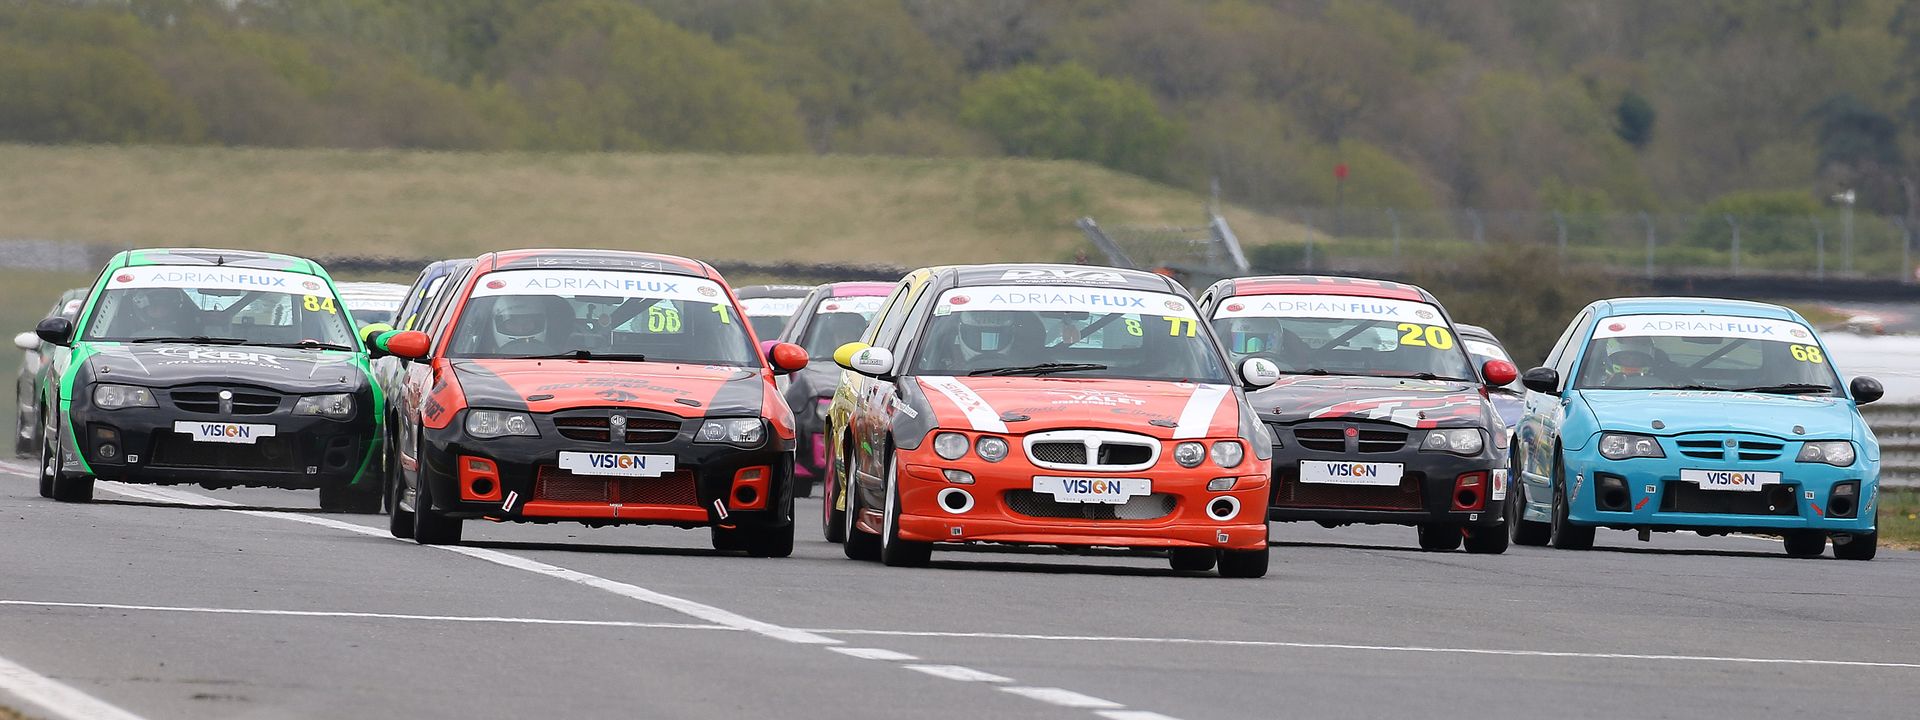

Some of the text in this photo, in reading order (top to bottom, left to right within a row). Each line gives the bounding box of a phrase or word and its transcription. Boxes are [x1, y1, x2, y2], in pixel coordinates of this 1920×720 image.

[303, 294, 337, 315] 84
[711, 303, 730, 324] 1
[1125, 319, 1143, 337] 8
[1162, 316, 1197, 337] 77
[1397, 323, 1453, 350] 20
[1789, 344, 1823, 364] 68
[1068, 395, 1146, 406] VALET
[201, 424, 250, 438] VISION
[589, 454, 646, 469] VISION
[1327, 463, 1377, 477] VISION
[1063, 479, 1120, 494] VISION
[1707, 472, 1755, 485] VISION
